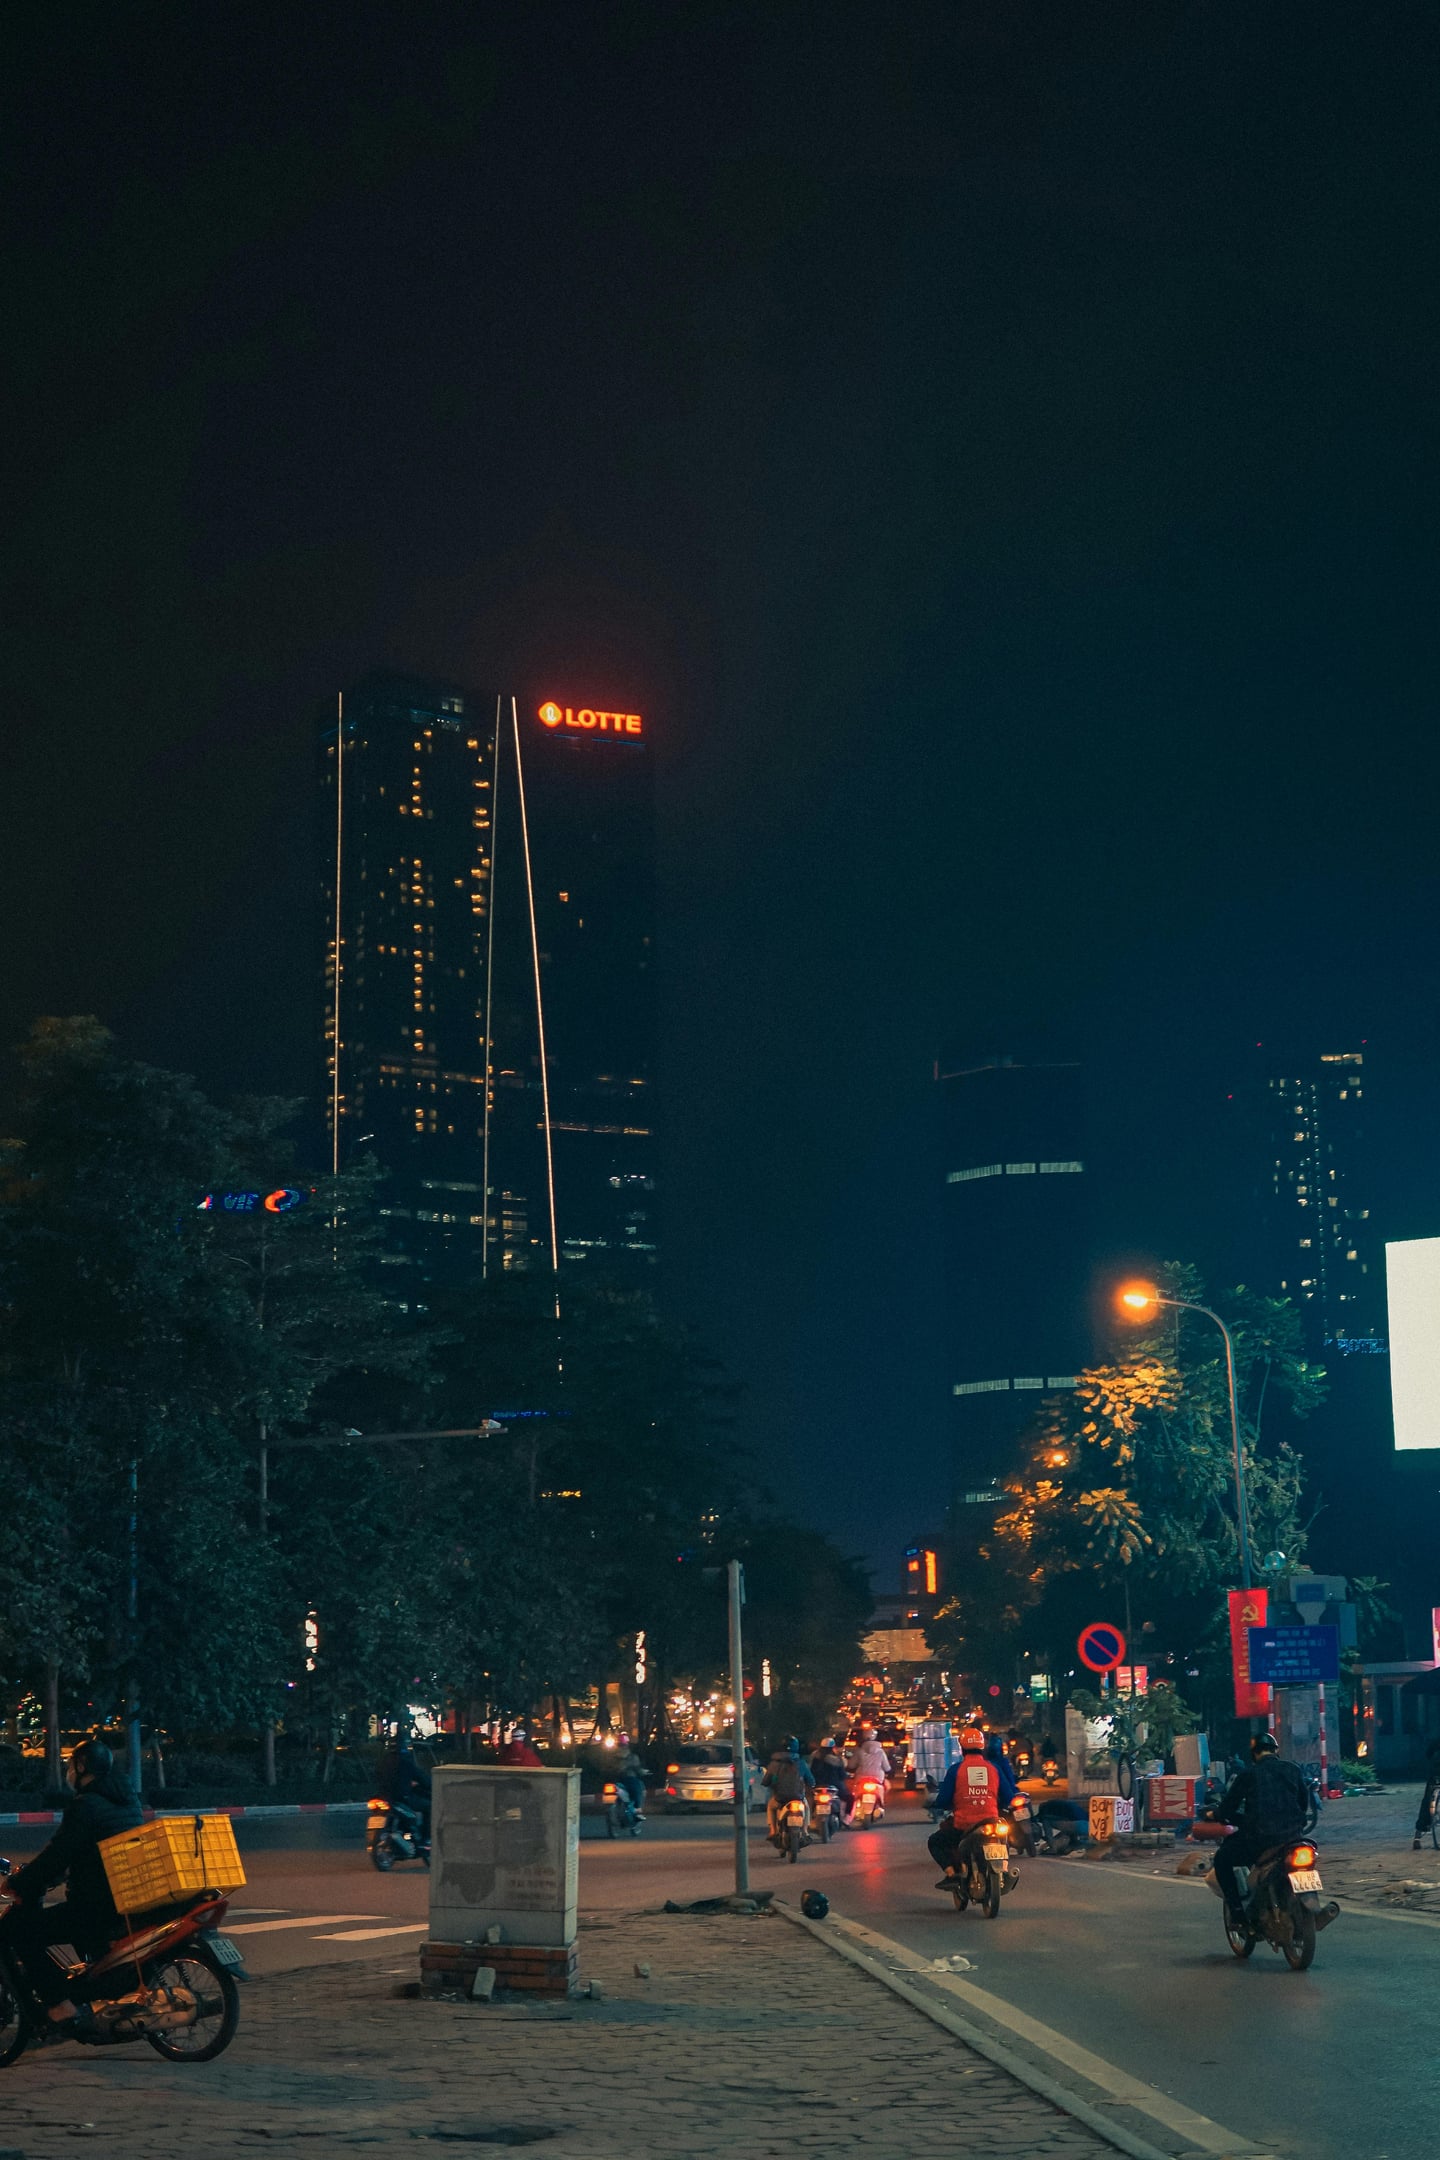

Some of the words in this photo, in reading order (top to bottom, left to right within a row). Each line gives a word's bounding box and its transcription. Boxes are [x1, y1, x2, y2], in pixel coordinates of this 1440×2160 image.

[565, 708, 642, 734] LOTTE
[968, 1787, 988, 1795] Now
[1164, 1779, 1188, 1817] MY
